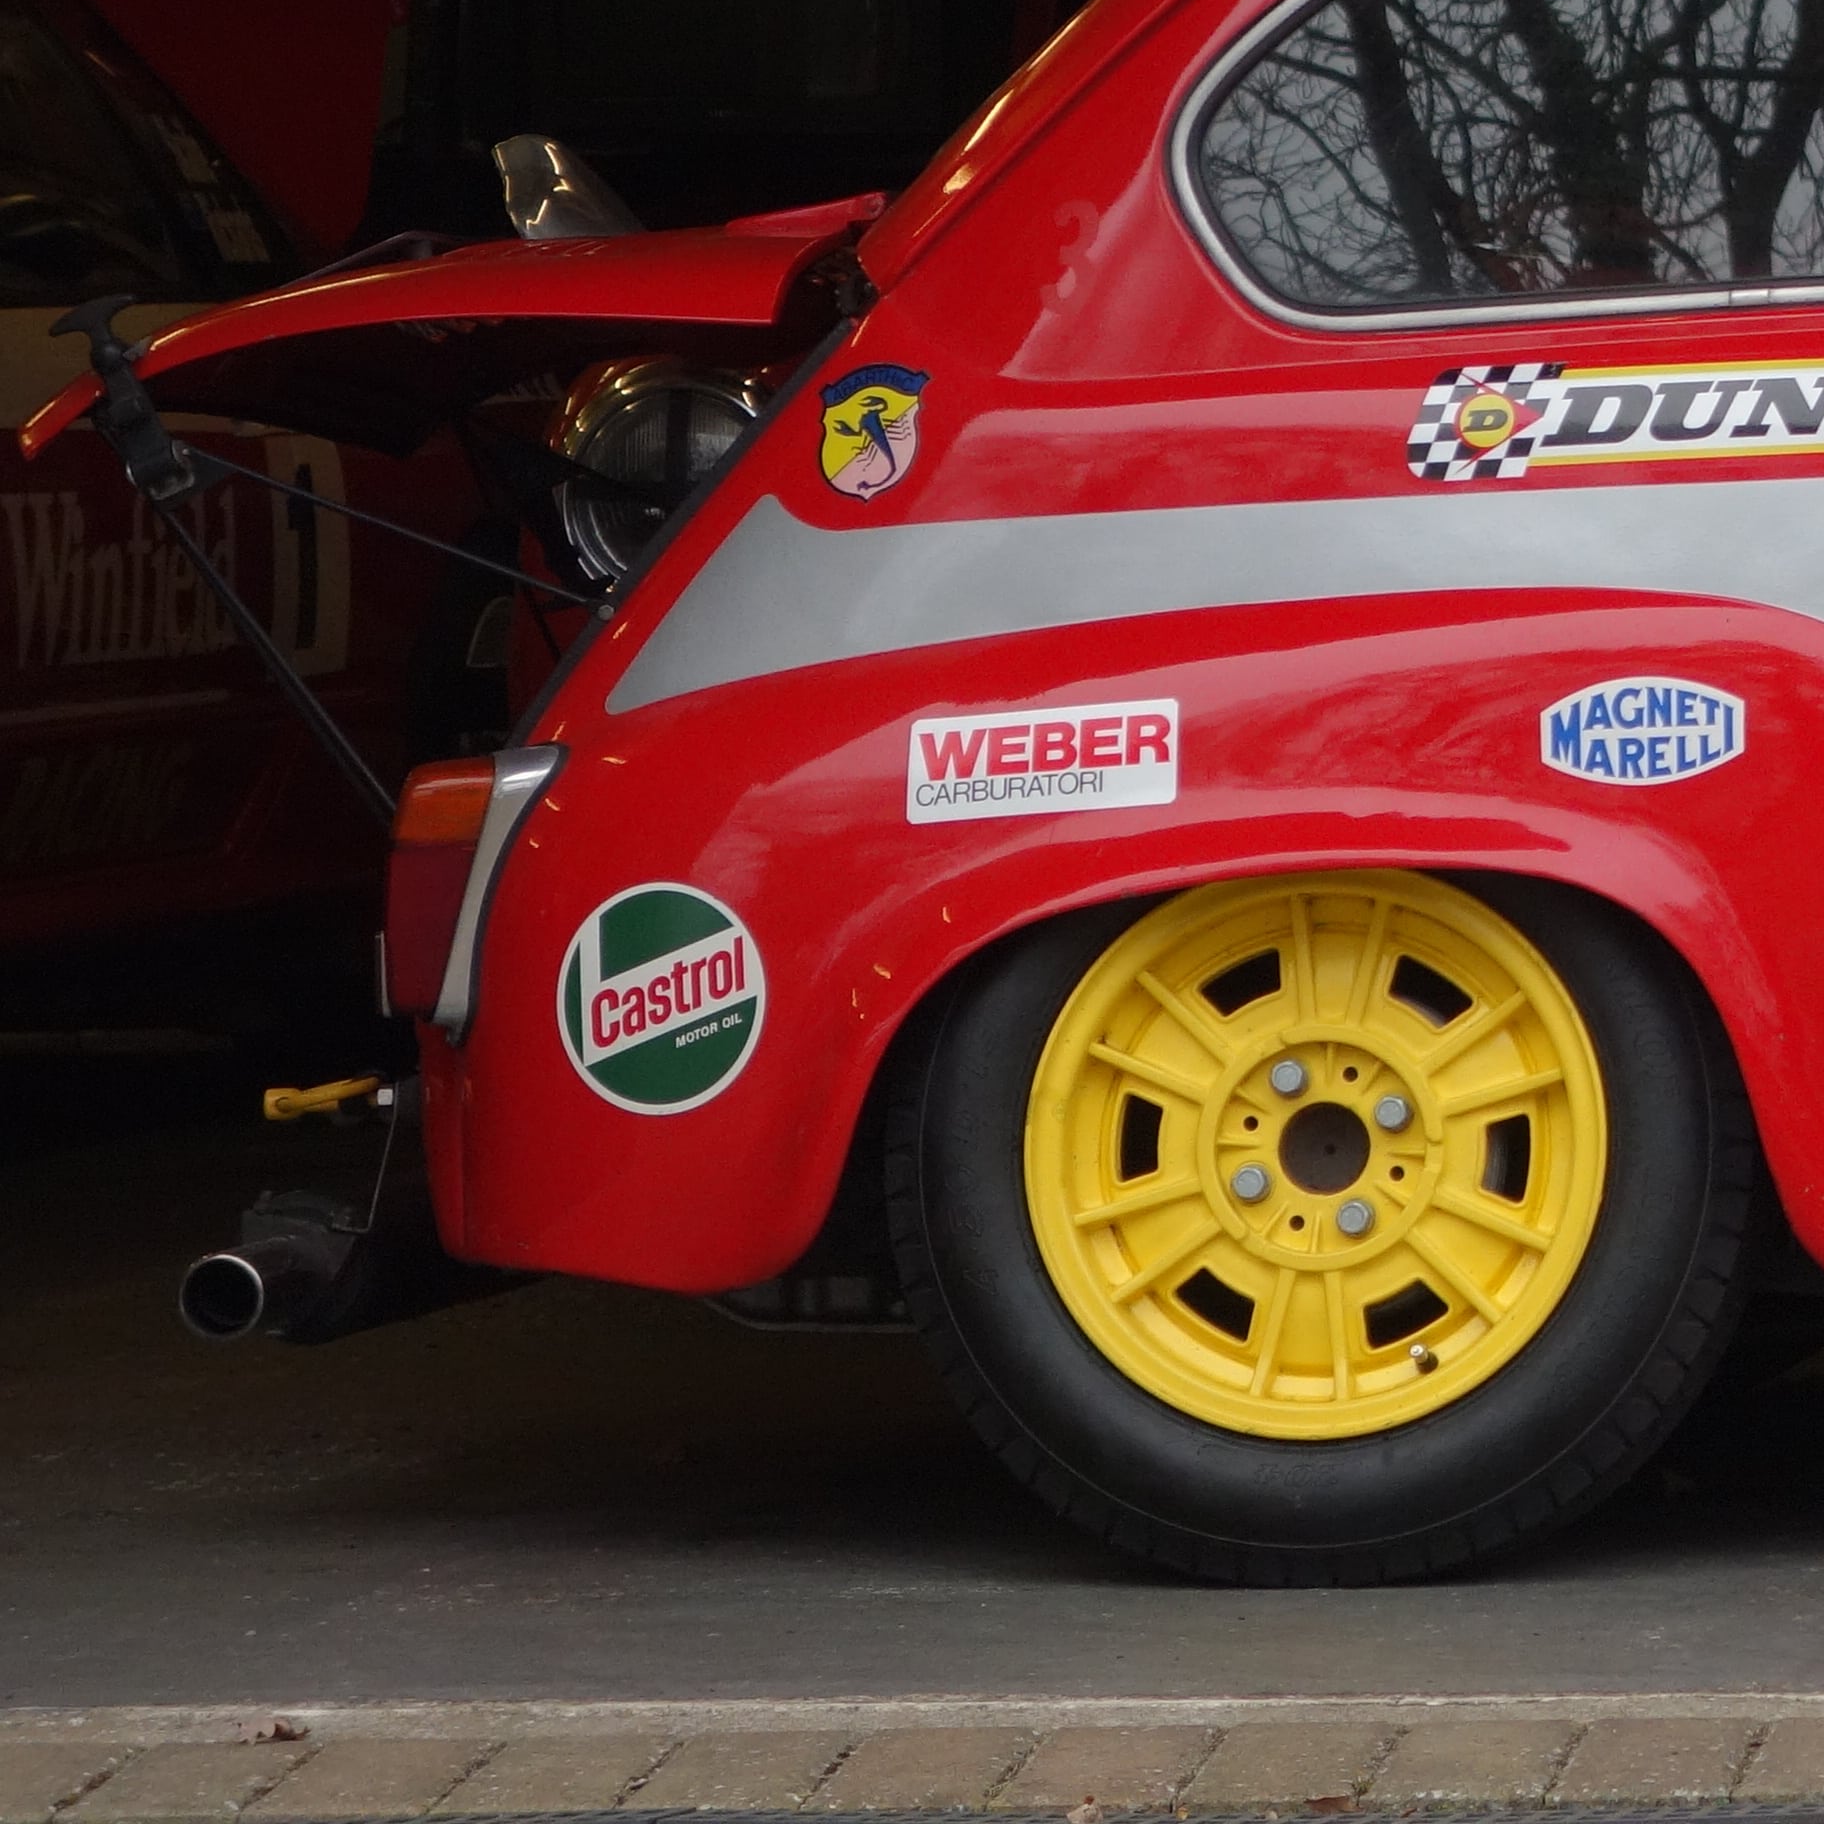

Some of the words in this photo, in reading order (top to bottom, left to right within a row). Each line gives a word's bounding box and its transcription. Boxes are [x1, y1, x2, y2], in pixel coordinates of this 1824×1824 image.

[1, 484, 239, 669] Winfield
[919, 713, 1172, 782] WEBER
[1550, 686, 1735, 769] MAGNETI
[1550, 701, 1735, 779] MARELLI
[915, 770, 1104, 807] CARBURATORI
[590, 934, 746, 1050] Castrol
[674, 1020, 719, 1050] MOTOR
[721, 1011, 743, 1029] OIL
